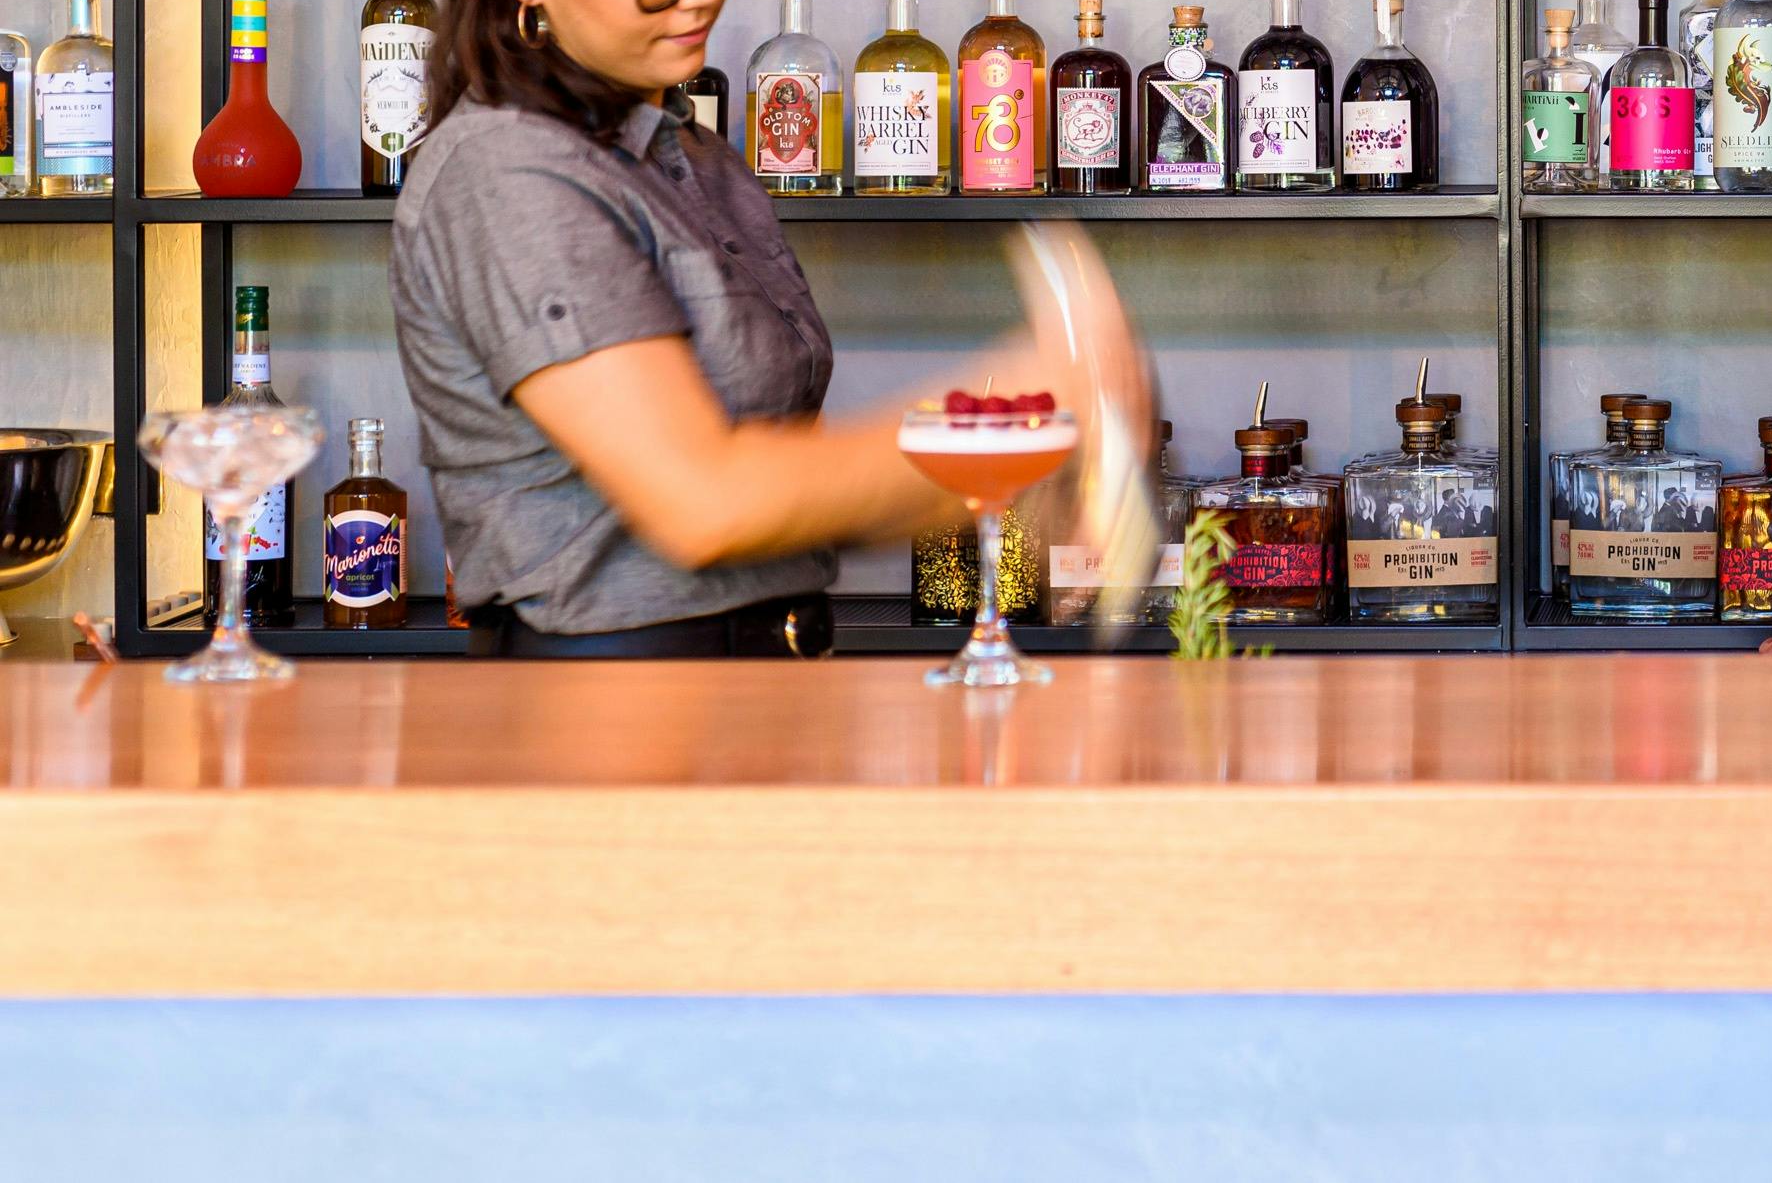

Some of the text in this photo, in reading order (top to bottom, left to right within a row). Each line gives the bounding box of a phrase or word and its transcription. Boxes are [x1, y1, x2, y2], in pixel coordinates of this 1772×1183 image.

[1261, 76, 1278, 90] kis
[1063, 92, 1114, 104] MONKEY 47
[377, 101, 408, 109] VERMOUTH
[1617, 95, 1671, 118] 36 S
[763, 112, 811, 126] OLD TOM
[857, 106, 929, 121] WHISKY
[1239, 107, 1311, 119] MULBERRY
[772, 123, 799, 135] GIN
[858, 123, 929, 138] BARREL
[1263, 121, 1309, 140] GIN
[780, 137, 794, 148] kis
[893, 139, 928, 154] GIN
[1152, 165, 1217, 173] ELEPHANT GIN
[325, 532, 401, 580] Marionette
[1608, 546, 1680, 559] PROHIBITION
[1385, 552, 1458, 568] PROHIBITION
[1632, 558, 1655, 571] GIN
[346, 573, 375, 582] apricot
[1244, 567, 1266, 580] GIN
[1410, 566, 1433, 579] GIN
